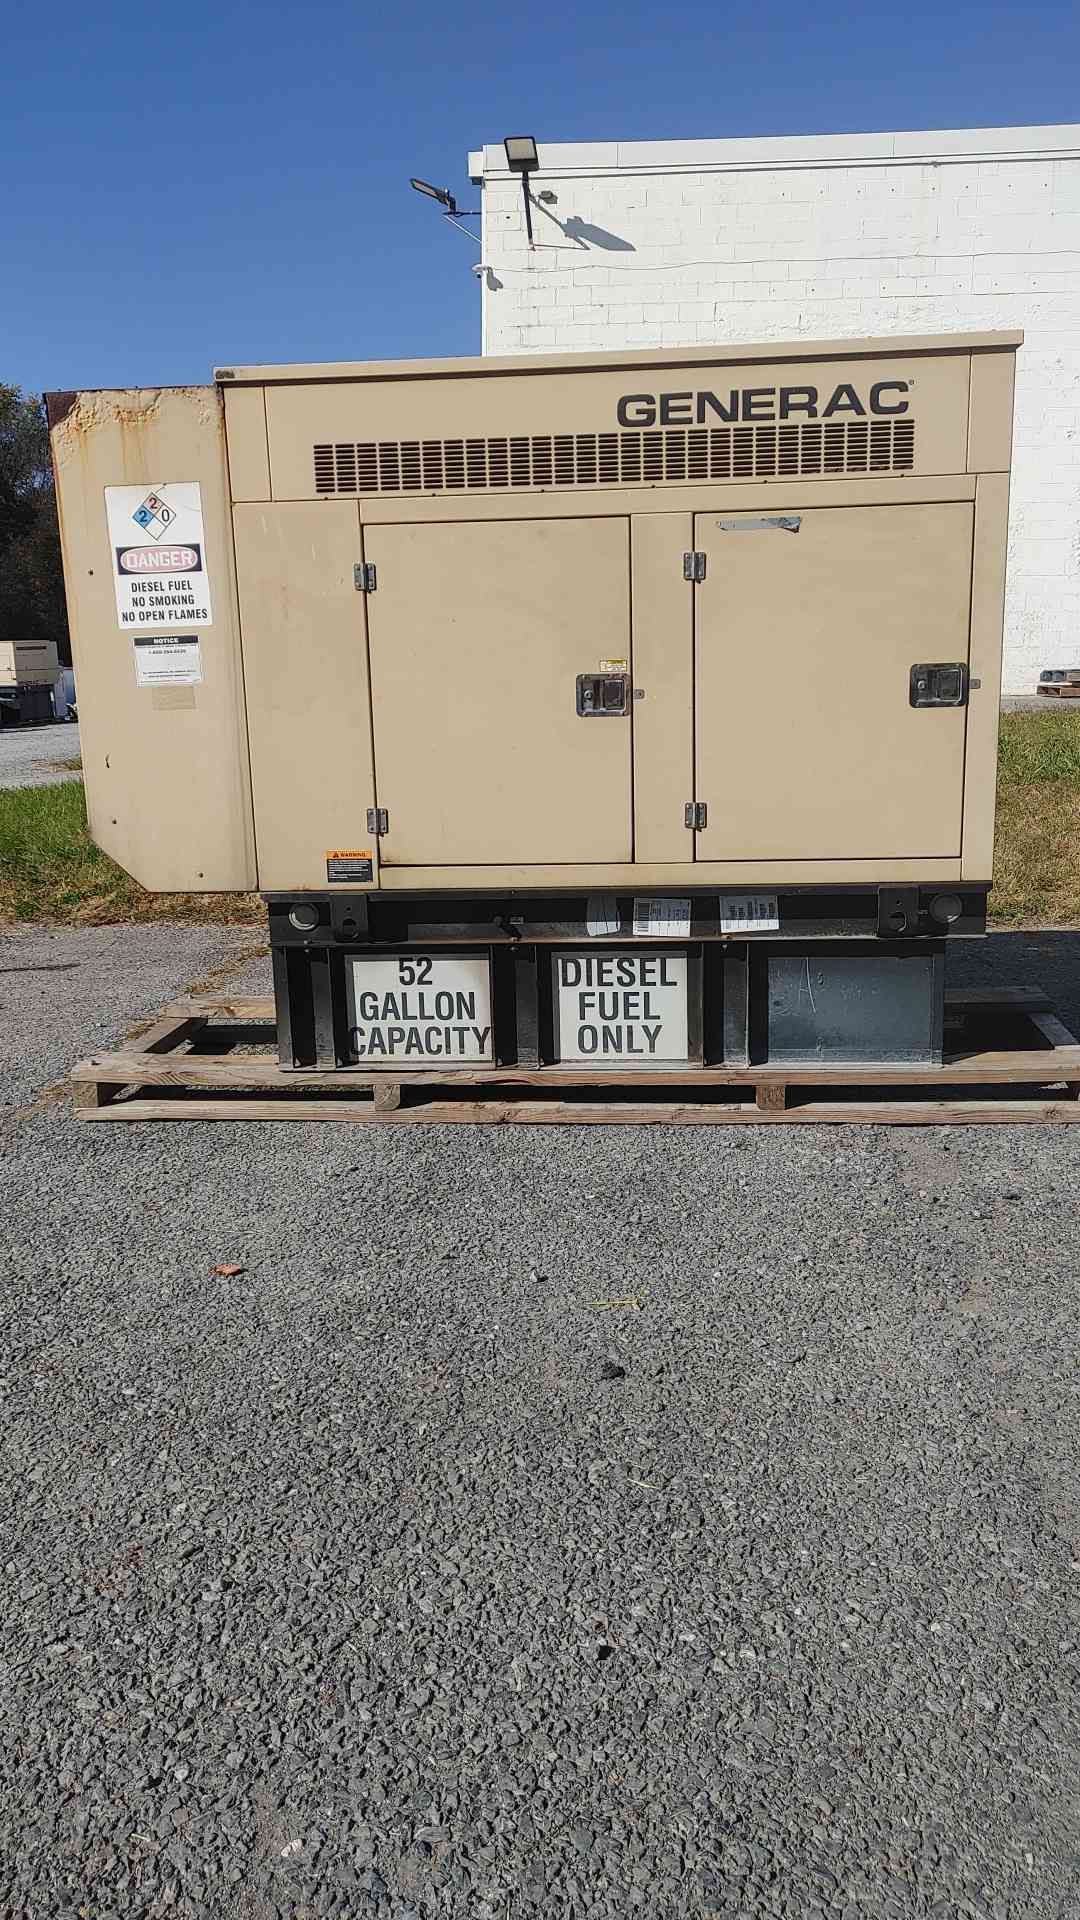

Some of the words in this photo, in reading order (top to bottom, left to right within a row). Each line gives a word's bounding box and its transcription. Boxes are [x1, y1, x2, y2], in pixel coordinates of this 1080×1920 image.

[617, 380, 910, 428] GENERAC
[138, 510, 147, 522] 2
[161, 508, 170, 521] 0
[148, 497, 157, 509] 2
[126, 551, 193, 567] DANGER
[131, 581, 165, 592] DIESEL
[168, 580, 192, 591] FUEL
[132, 596, 145, 606] NO
[149, 594, 194, 606] SMOKING
[121, 611, 135, 622] NO
[138, 610, 165, 621] OPEN
[168, 608, 208, 620] FLAMES
[398, 957, 433, 986] 52
[561, 957, 678, 987] DIESEL
[360, 991, 476, 1021] GALLON
[579, 991, 661, 1021] FUEL
[350, 1026, 491, 1056] CAPACITY
[577, 1024, 663, 1054] ONLY
